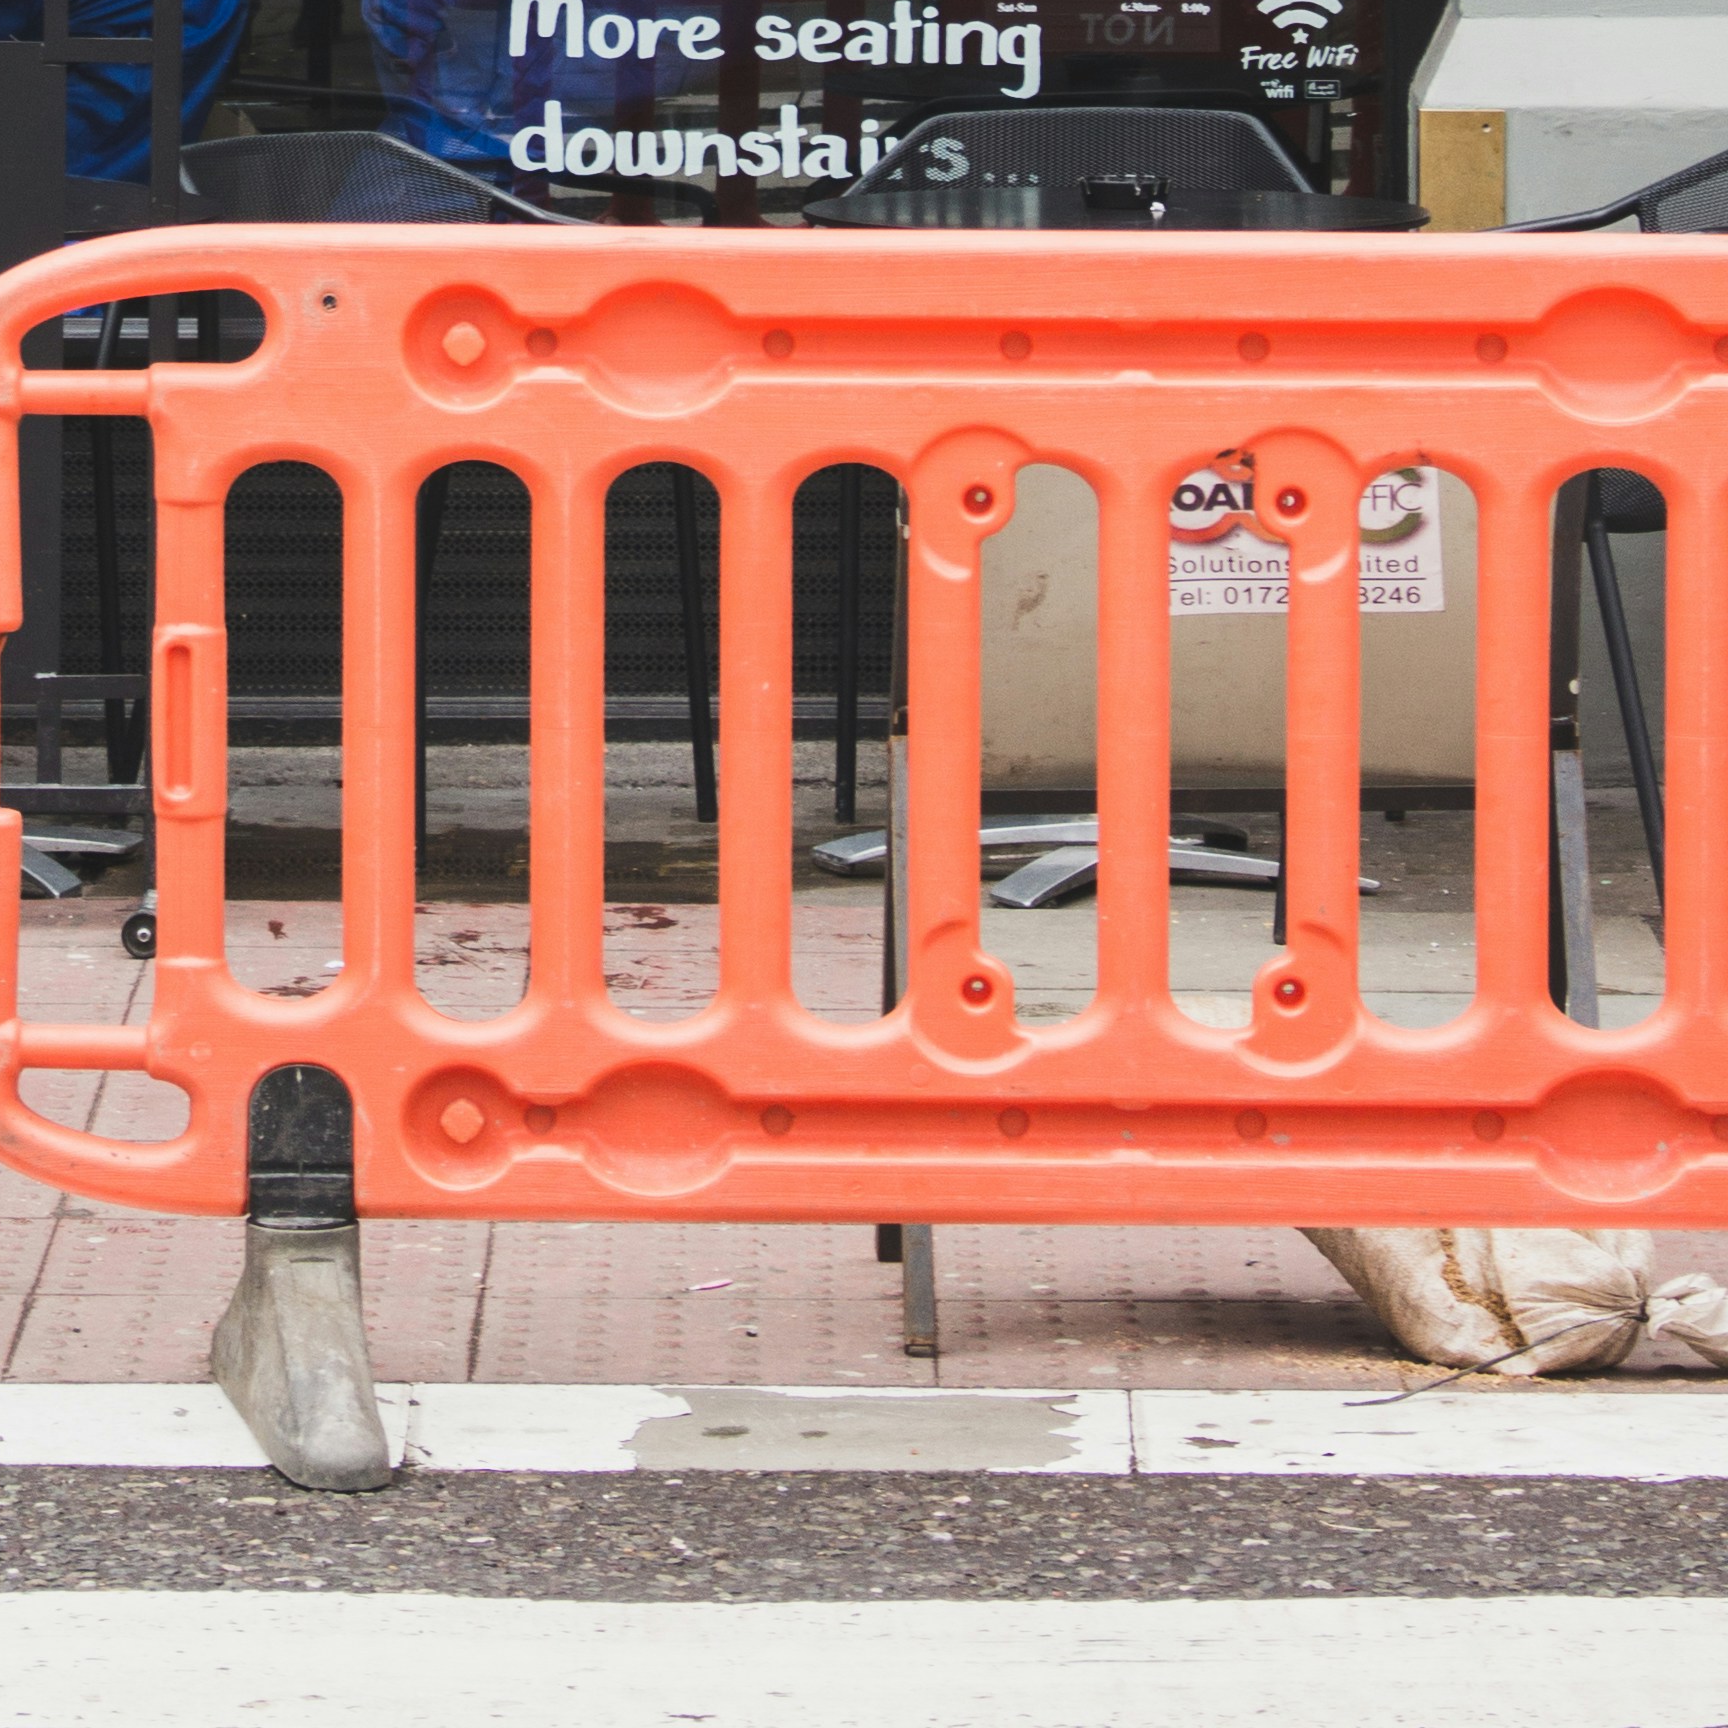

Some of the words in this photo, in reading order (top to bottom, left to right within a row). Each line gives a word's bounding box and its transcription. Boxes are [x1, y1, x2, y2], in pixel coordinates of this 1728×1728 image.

[997, 2, 1038, 13] Sat-Sun
[755, 0, 1041, 100] seating
[1240, 45, 1299, 70] Free
[1306, 44, 1360, 69] WiFi
[1265, 84, 1295, 98] wifi
